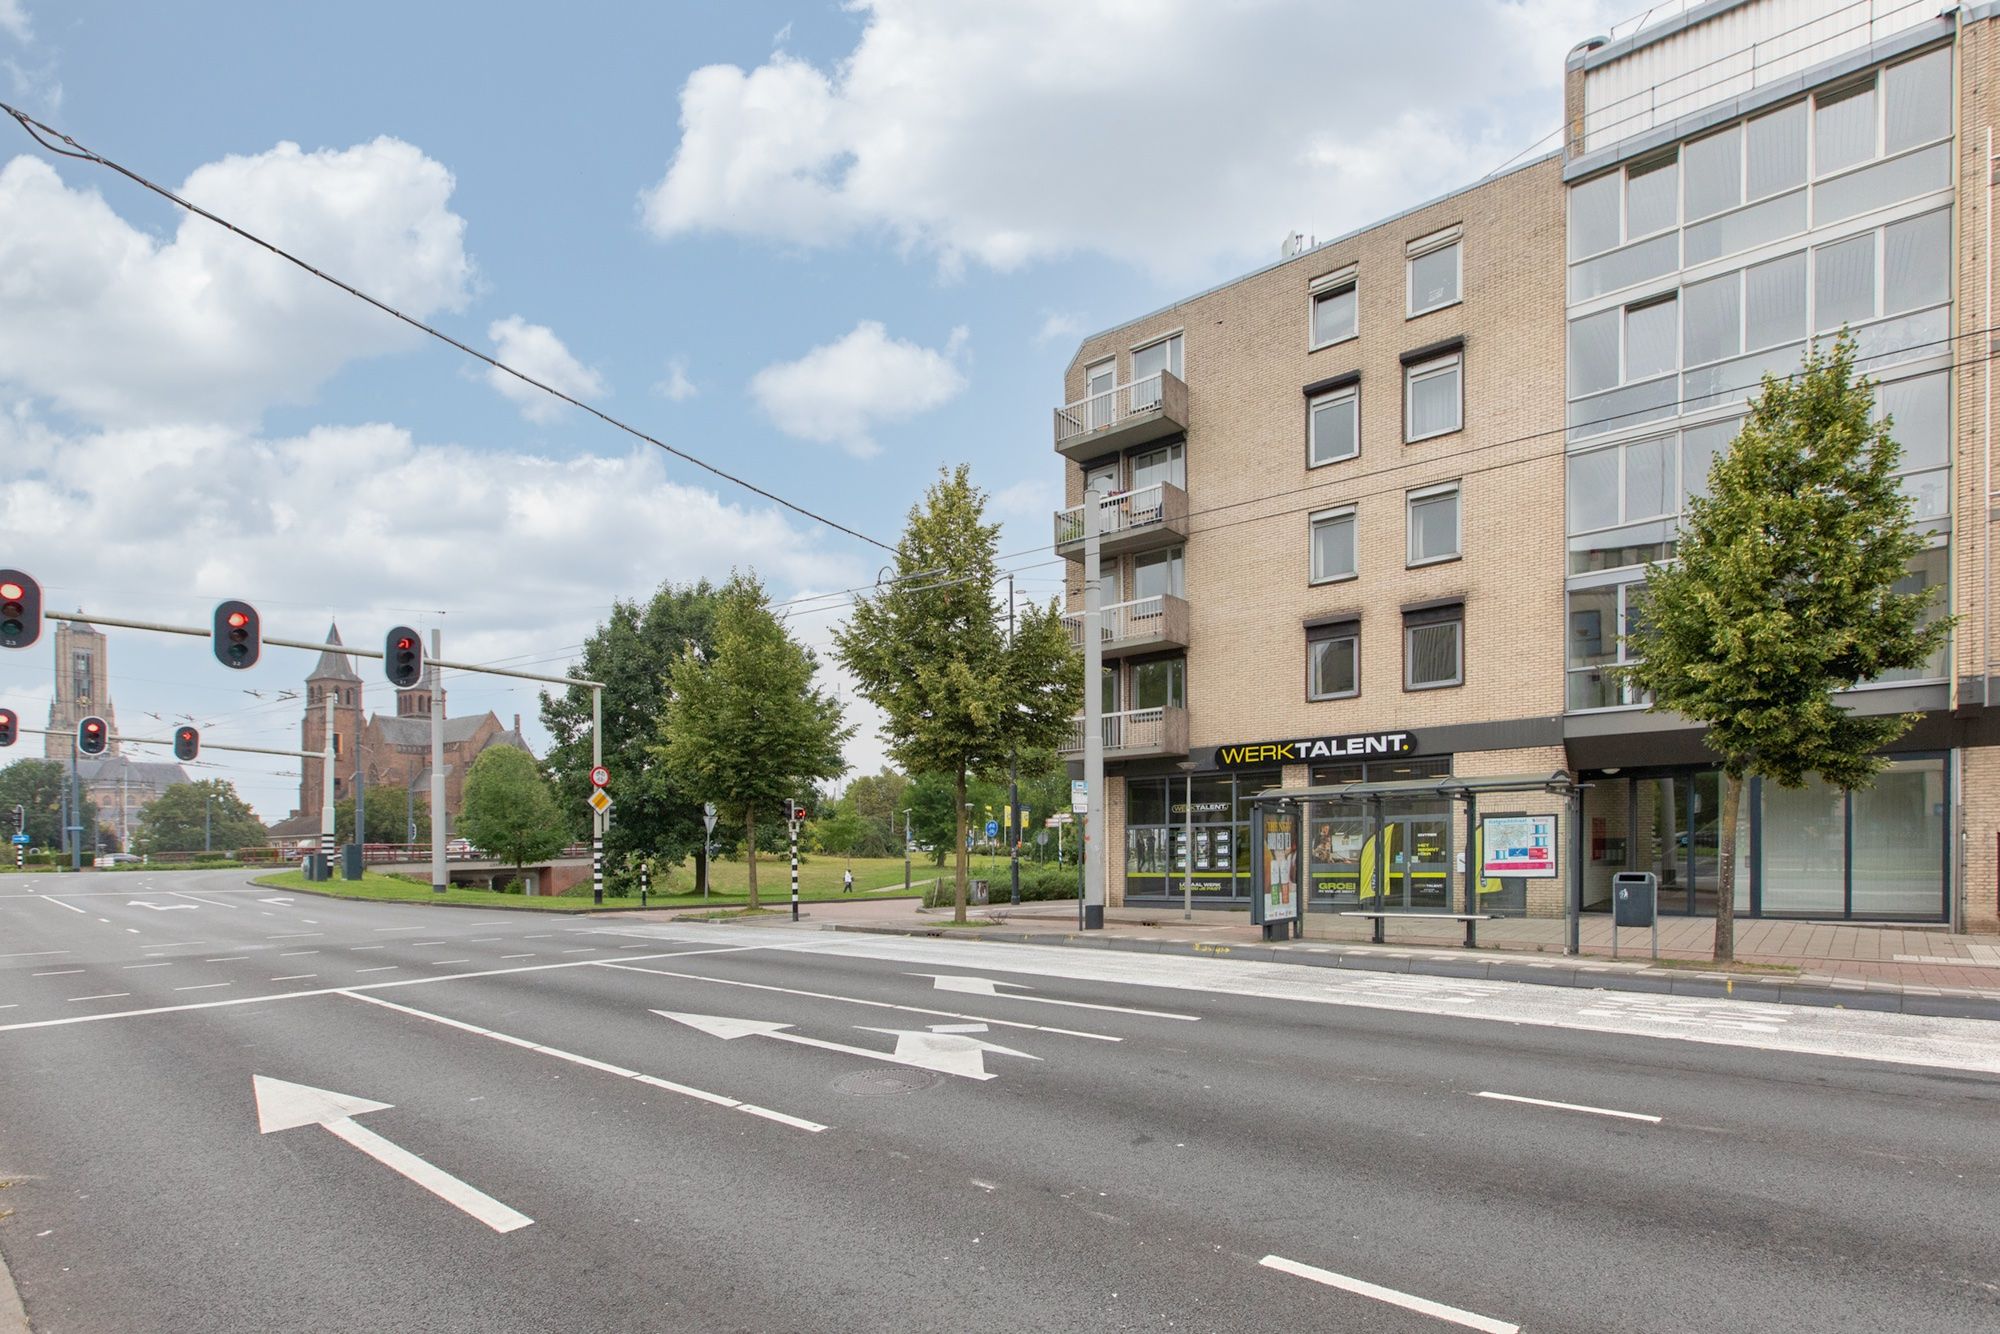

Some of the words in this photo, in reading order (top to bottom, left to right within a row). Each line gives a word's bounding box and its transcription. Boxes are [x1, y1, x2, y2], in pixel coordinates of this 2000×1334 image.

[1222, 734, 1409, 764] WERKTALENT.
[1318, 882, 1356, 890] GROEI
[1577, 996, 1795, 1033] BUS
